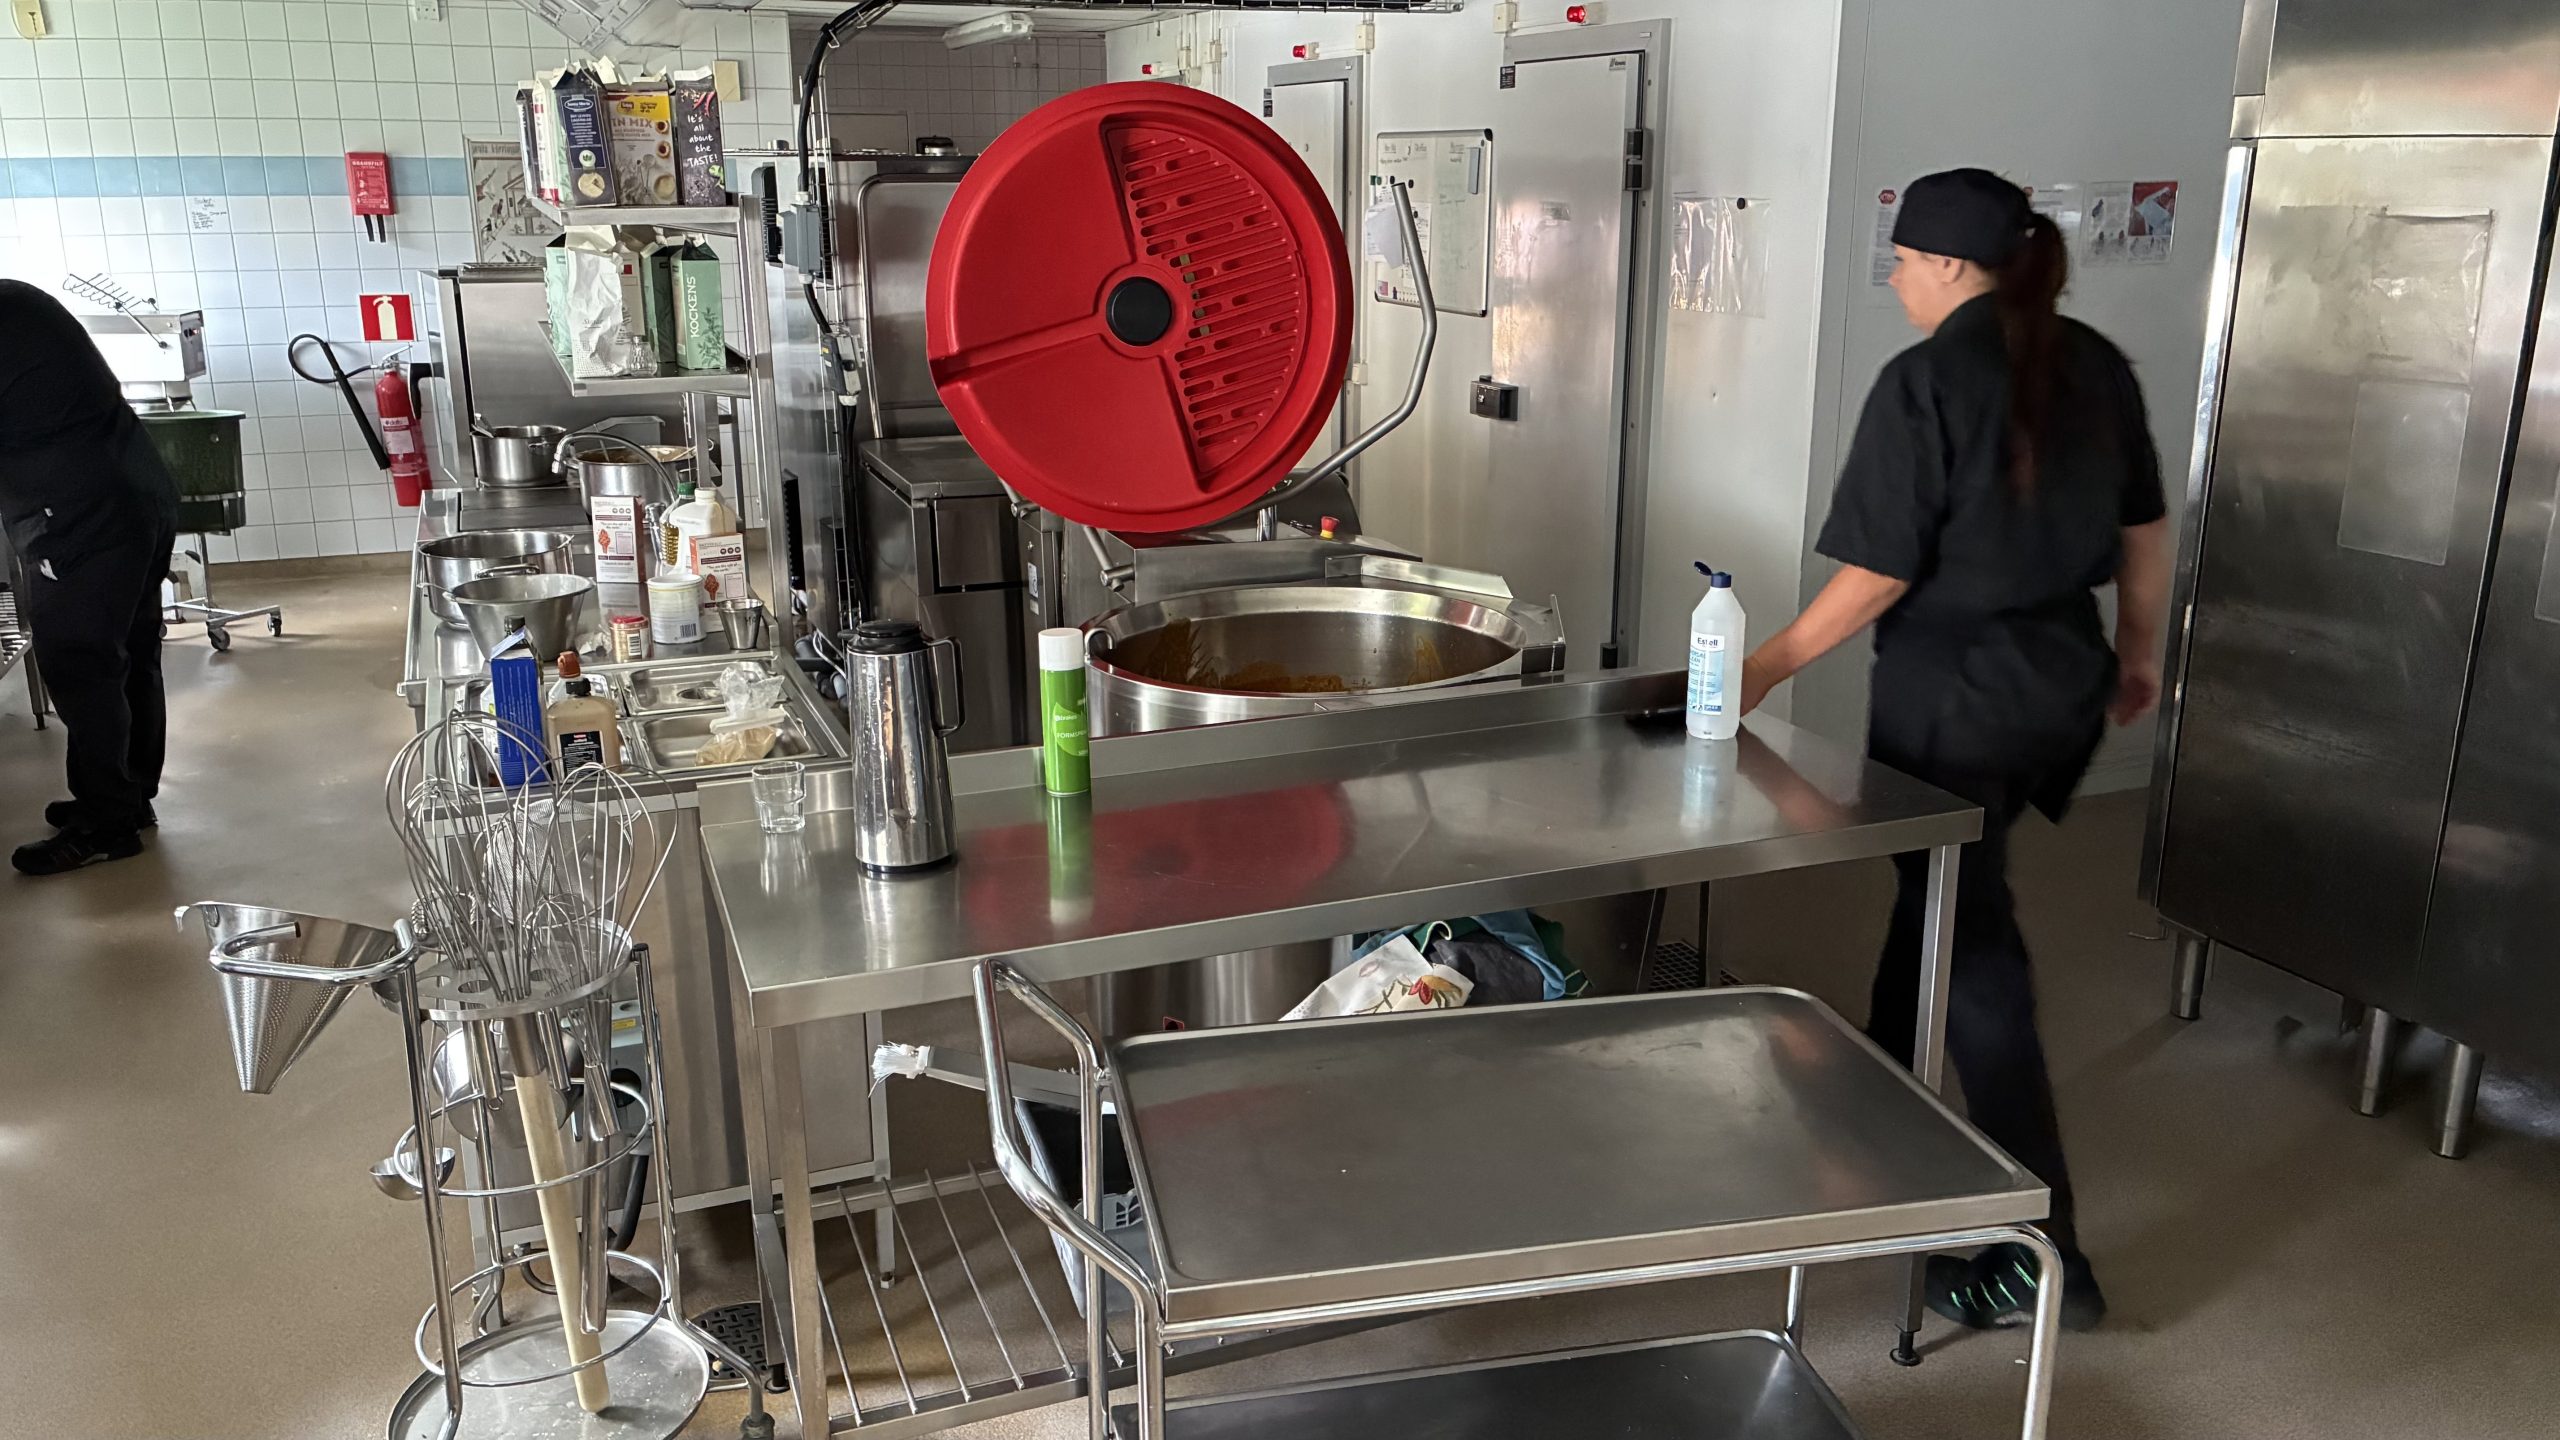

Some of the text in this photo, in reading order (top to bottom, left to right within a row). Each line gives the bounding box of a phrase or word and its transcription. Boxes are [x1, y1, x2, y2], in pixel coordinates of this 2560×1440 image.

[687, 113, 703, 123] It's
[693, 123, 705, 132] all
[689, 133, 714, 143] about
[695, 144, 711, 153] the
[687, 153, 718, 168] TASTE!
[686, 276, 700, 338] KOCKENS
